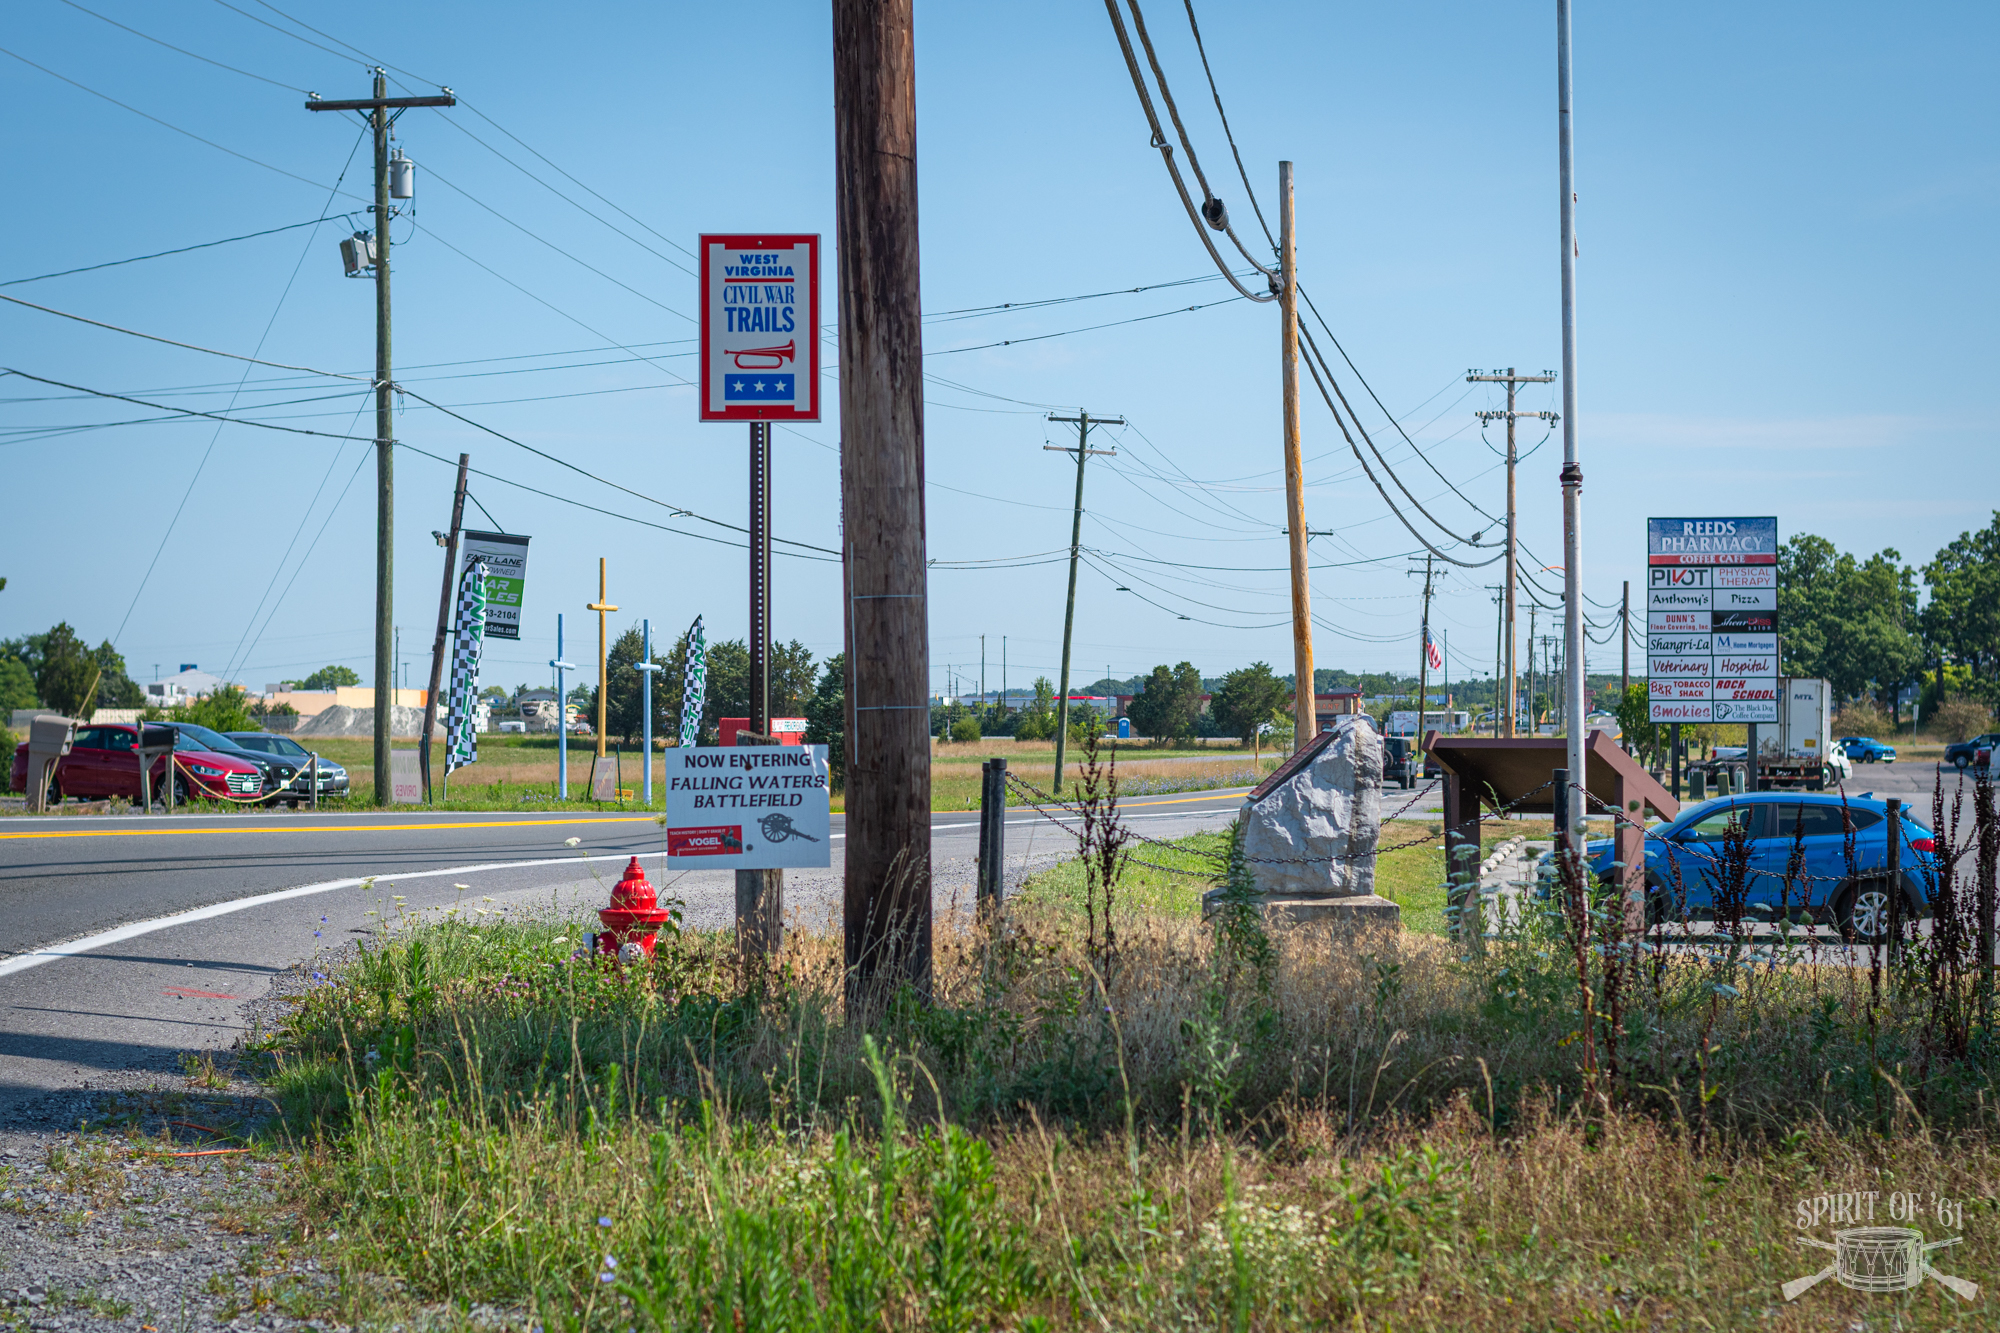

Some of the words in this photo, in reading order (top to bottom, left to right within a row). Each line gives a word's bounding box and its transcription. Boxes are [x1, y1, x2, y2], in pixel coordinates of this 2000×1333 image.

[740, 254, 779, 264] WEST
[724, 266, 794, 276] VIRGINIA
[724, 286, 762, 304] CIVIL
[764, 286, 795, 304] WAR
[724, 306, 795, 332] TRAILS
[1684, 521, 1736, 536] REEDS
[1662, 536, 1763, 552] PHARMACY
[494, 556, 524, 566] LANE
[1680, 554, 1716, 564] COFFEE
[1719, 554, 1746, 564] CAFE
[1652, 569, 1708, 586] PIVOT
[1720, 568, 1770, 576] PHYSICAL
[486, 579, 510, 590] AR
[1720, 578, 1770, 586] THERAPY
[486, 591, 520, 604] LES
[1652, 594, 1709, 606] Anthony's
[1731, 594, 1760, 604] Pizza
[1666, 614, 1696, 623] DUNN'S
[1748, 617, 1772, 626] bliss
[1650, 638, 1710, 654] Shangri-La
[1748, 642, 1774, 650] Mortgages
[1653, 660, 1709, 676] Veterinary
[1720, 658, 1770, 676] Hospital
[1650, 681, 1672, 696] B&R
[1716, 680, 1746, 689] ROCK
[1732, 690, 1775, 700] SCHOOL
[1652, 705, 1711, 718] Smokies
[1750, 712, 1776, 720] Company
[684, 754, 725, 768] NOW
[730, 753, 811, 768] ENTERING
[670, 776, 744, 790] FALLING
[748, 774, 826, 789] WATERS
[694, 793, 803, 808] BATTLEFIELD
[688, 837, 721, 846] VOGEL
